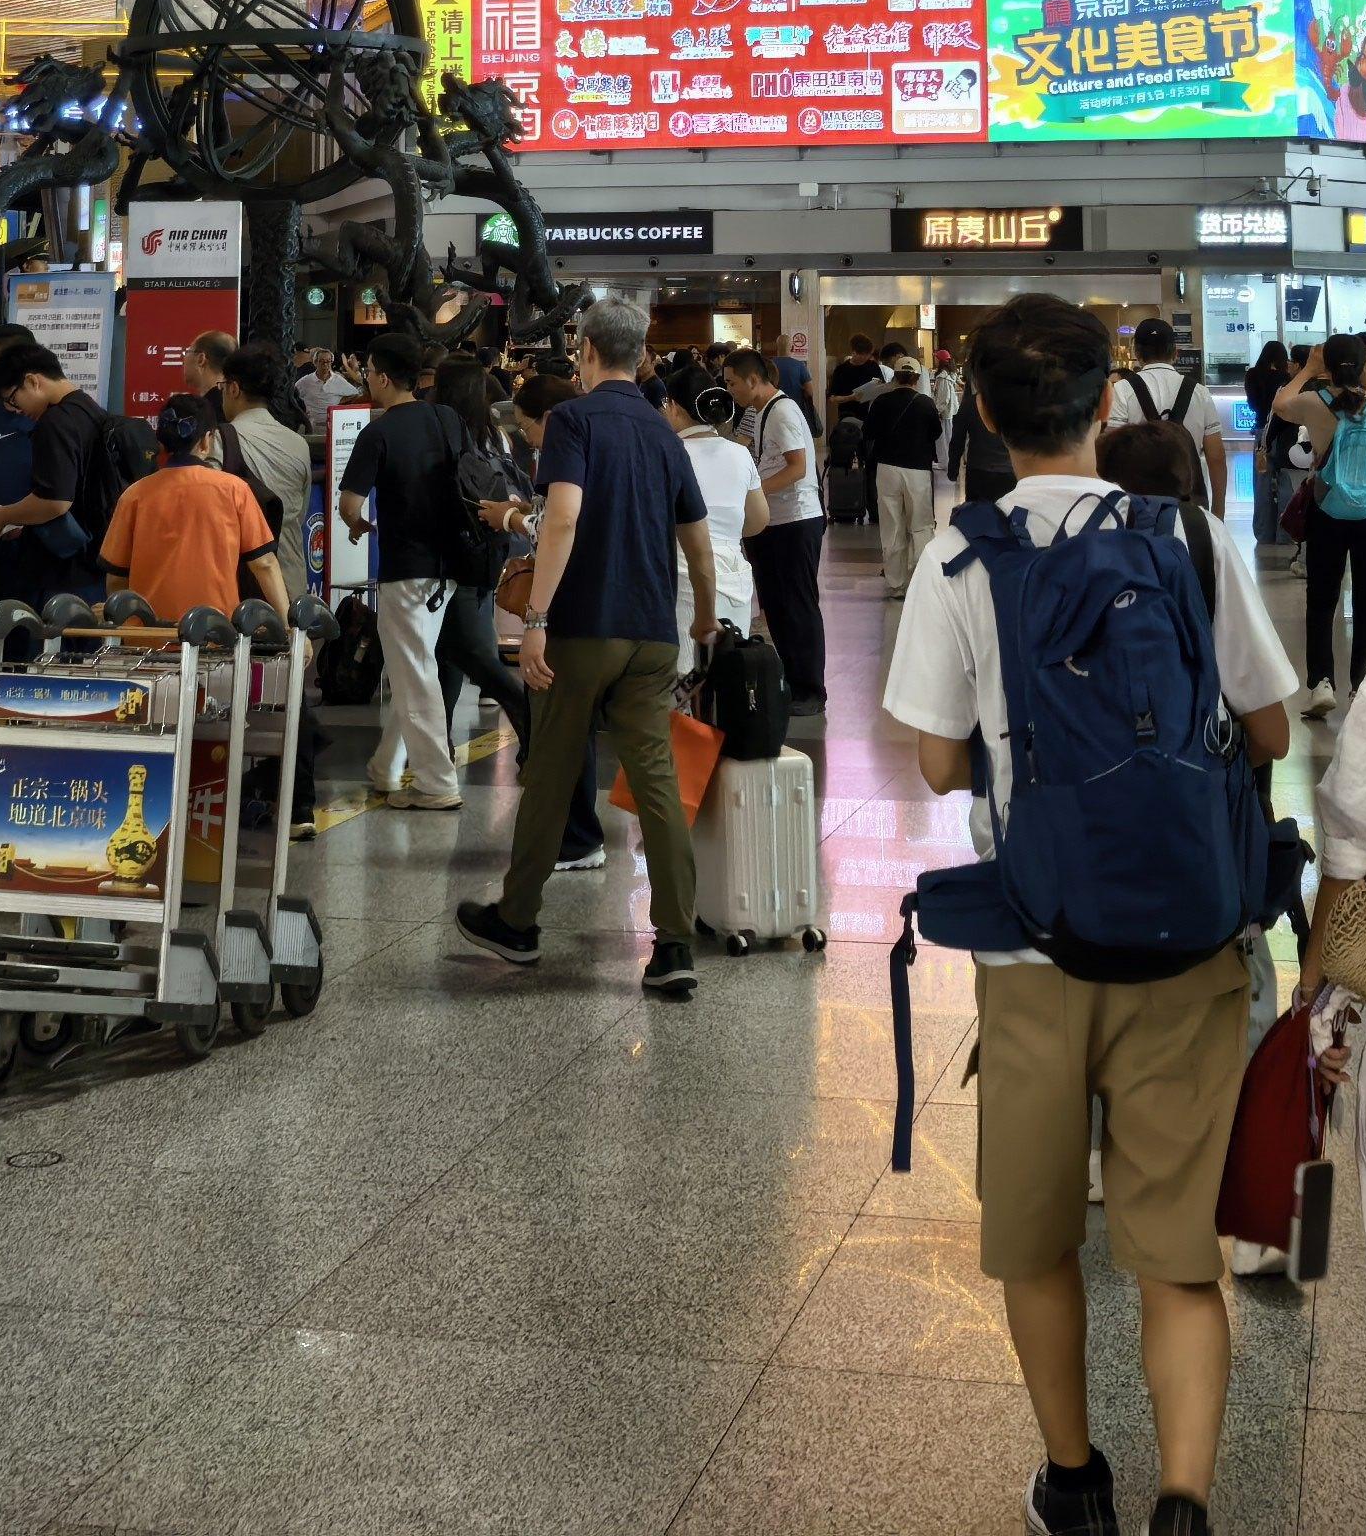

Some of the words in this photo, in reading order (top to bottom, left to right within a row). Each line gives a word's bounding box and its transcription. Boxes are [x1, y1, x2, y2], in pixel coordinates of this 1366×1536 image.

[1017, 9, 1258, 80] 文化美食节
[482, 53, 540, 64] BEIJING
[1049, 79, 1103, 95] Culture
[1106, 73, 1134, 89] and
[1136, 69, 1173, 86] Food
[1176, 63, 1231, 82] Festival
[169, 230, 189, 240] AIR
[191, 229, 228, 240] CHINA
[543, 227, 634, 241] TARBUCKS
[637, 226, 703, 240] COFFEE
[923, 214, 1050, 246] 原麦山丘
[1200, 212, 1287, 235] 货币兑换
[144, 280, 167, 288] STAR
[169, 280, 211, 288] ALLIANCE
[10, 777, 108, 803] 正宗二锅头
[9, 803, 107, 830] 地道北京味
